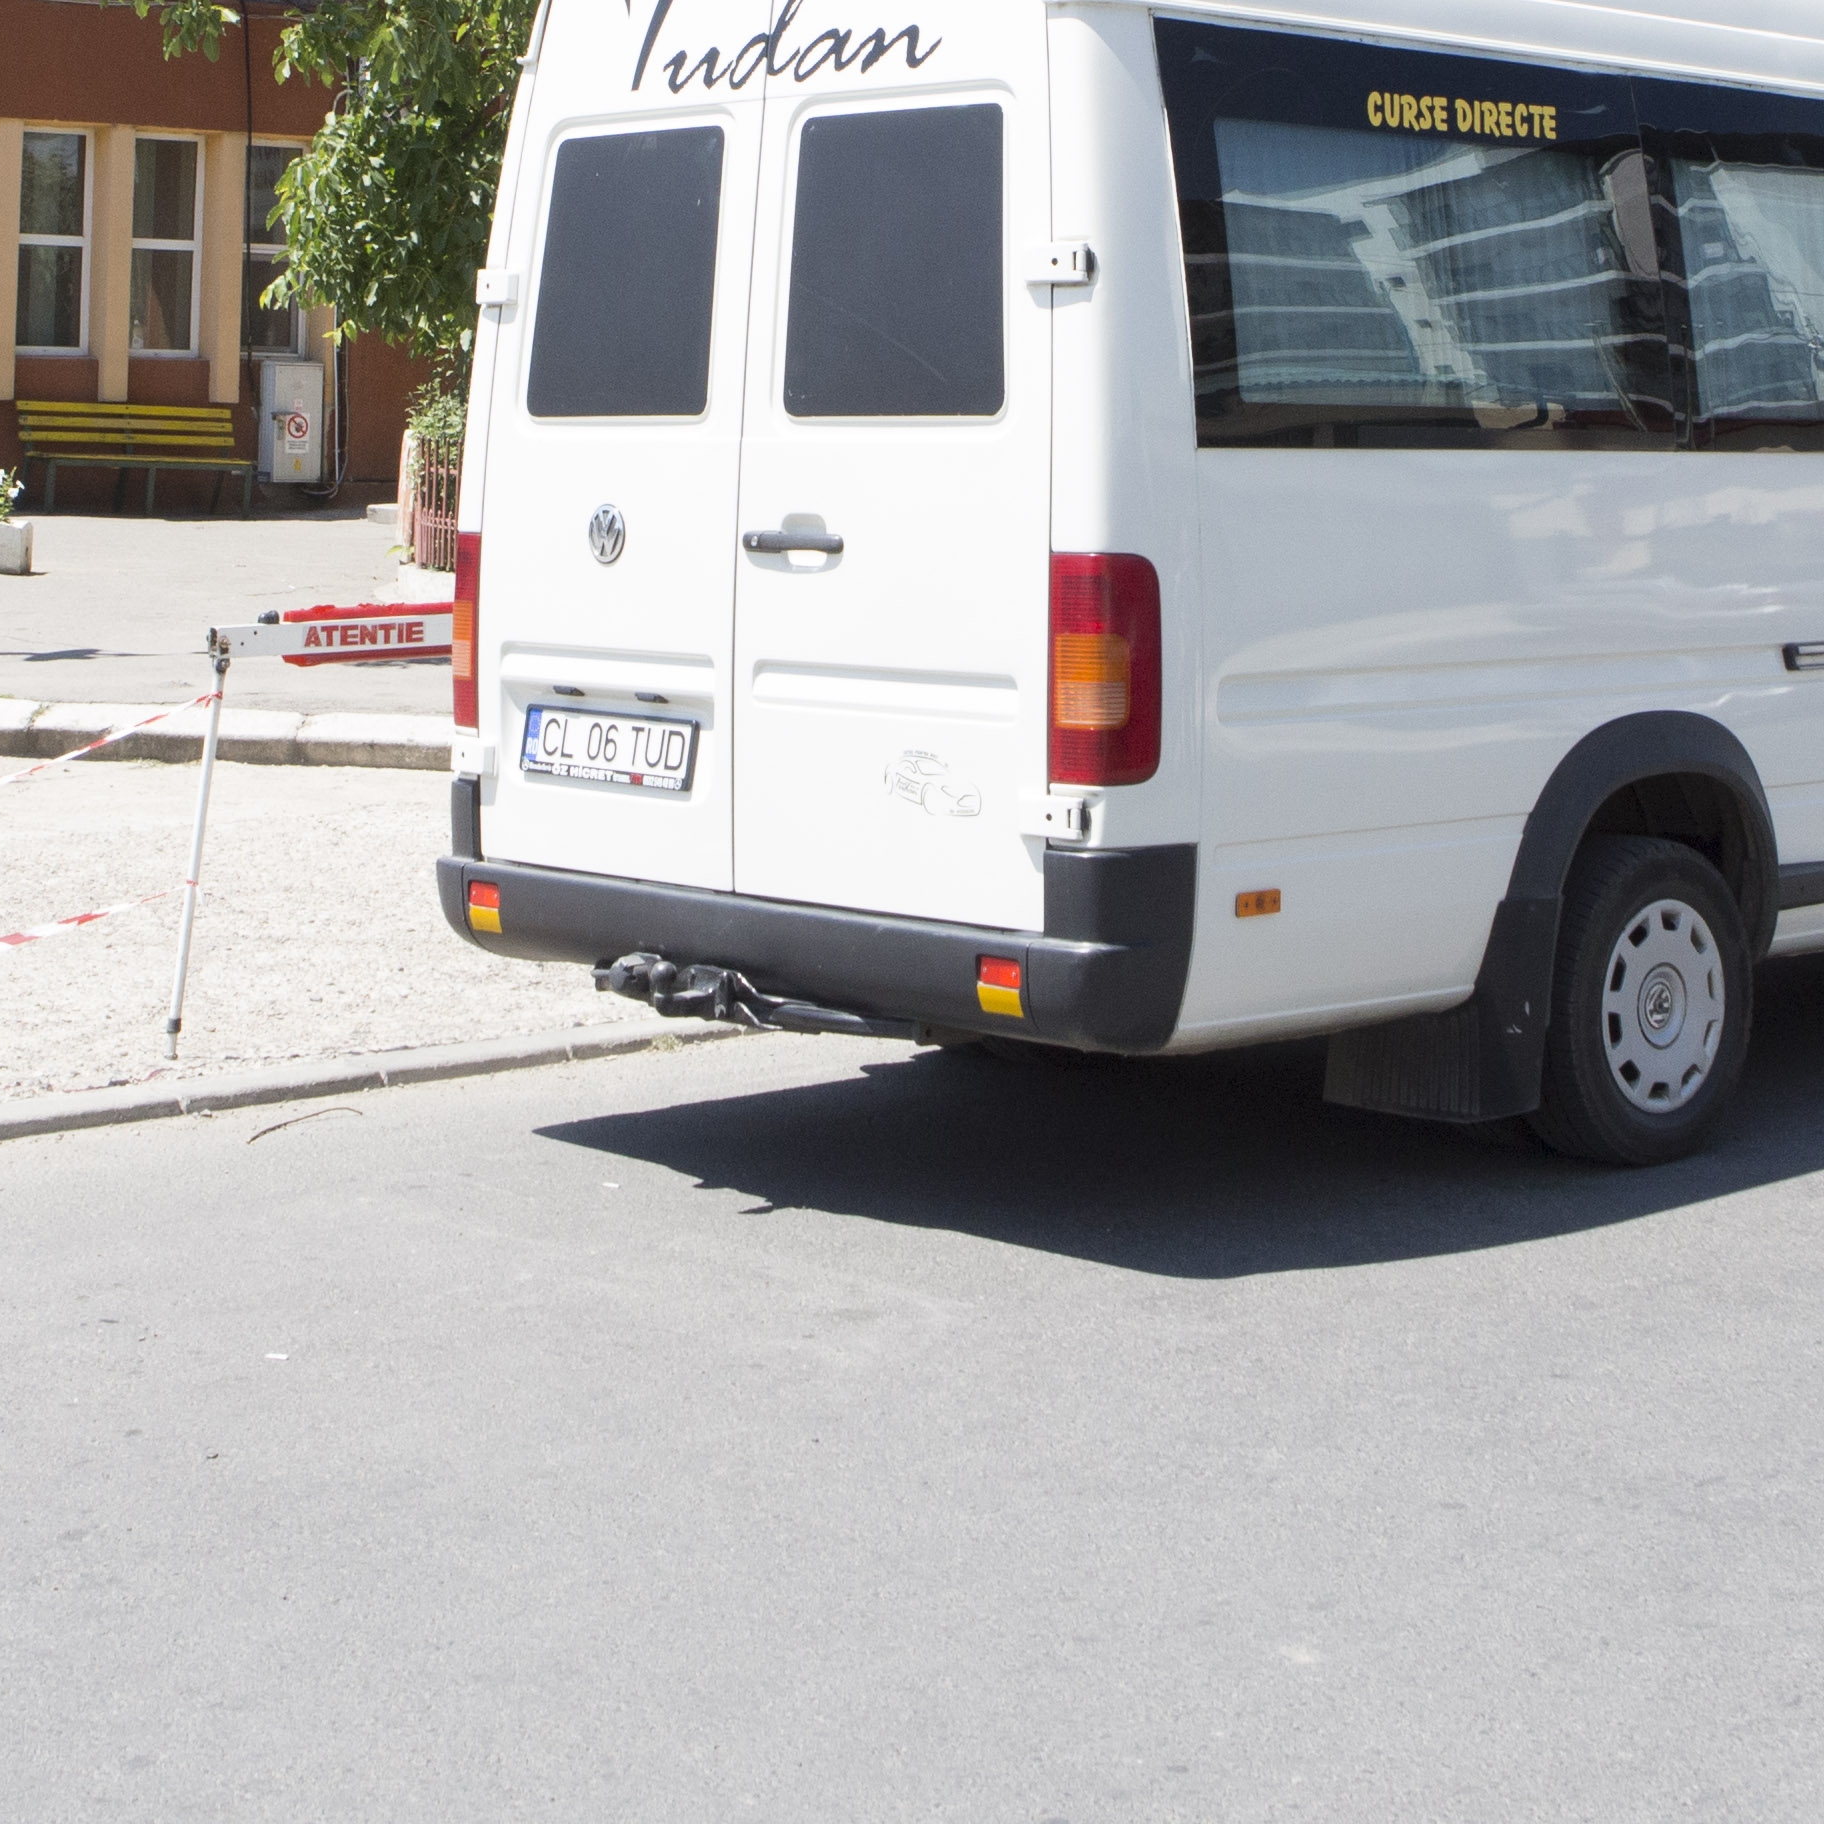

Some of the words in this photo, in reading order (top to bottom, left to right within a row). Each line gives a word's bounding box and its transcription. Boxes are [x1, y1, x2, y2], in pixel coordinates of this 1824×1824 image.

[1367, 91, 1448, 132] CURSE
[1454, 98, 1557, 140] DIRECTE
[304, 621, 424, 648] ATENTIE
[542, 717, 574, 759] CL
[587, 722, 619, 763] 06
[631, 726, 686, 771] TUD
